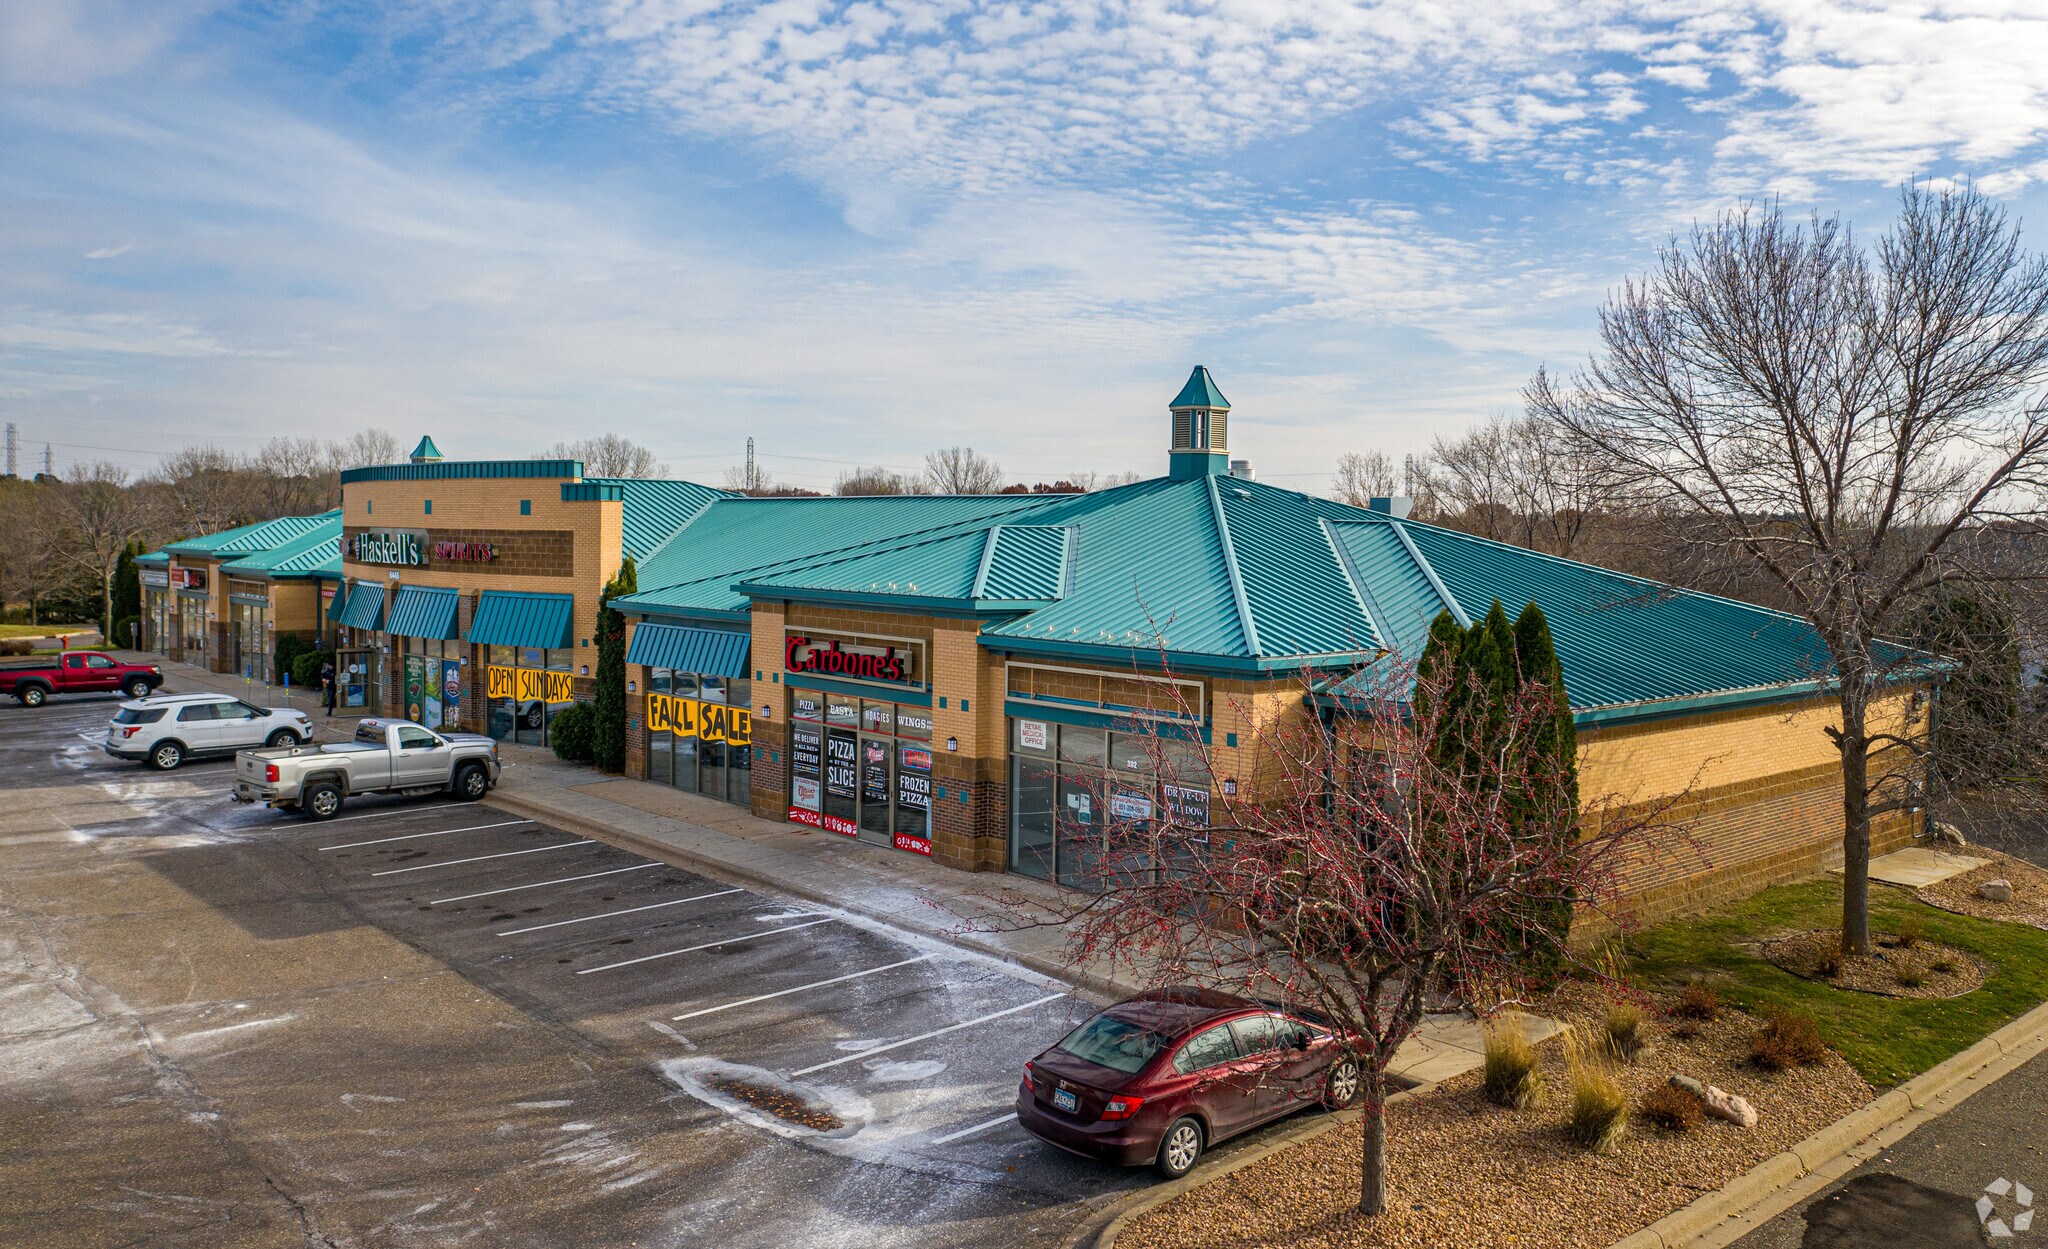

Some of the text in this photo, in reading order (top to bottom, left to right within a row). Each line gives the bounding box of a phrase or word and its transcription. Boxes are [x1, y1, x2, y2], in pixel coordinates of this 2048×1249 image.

[360, 533, 419, 566] Haskell's
[435, 541, 492, 561] SPIRITS
[785, 636, 900, 680] Carbone's
[488, 667, 574, 701] OPEN SUNDAYS!
[649, 695, 694, 731] FALL
[799, 700, 815, 711] PIZZA
[865, 710, 890, 723] HOAGIES
[897, 715, 926, 729] WINGS
[1022, 729, 1045, 739] MEDICAL
[1024, 723, 1043, 732] RETAIL
[1024, 736, 1044, 746] OFFICE
[793, 751, 819, 764] EVERYDAY
[828, 739, 855, 761] PIZZA
[904, 749, 930, 768] OPEN
[828, 766, 855, 788] SLICE
[900, 775, 930, 794] FROZEN
[900, 790, 929, 807] PIZZA
[1167, 787, 1206, 802] DRVE-UP
[1169, 802, 1205, 817] WIDOW
